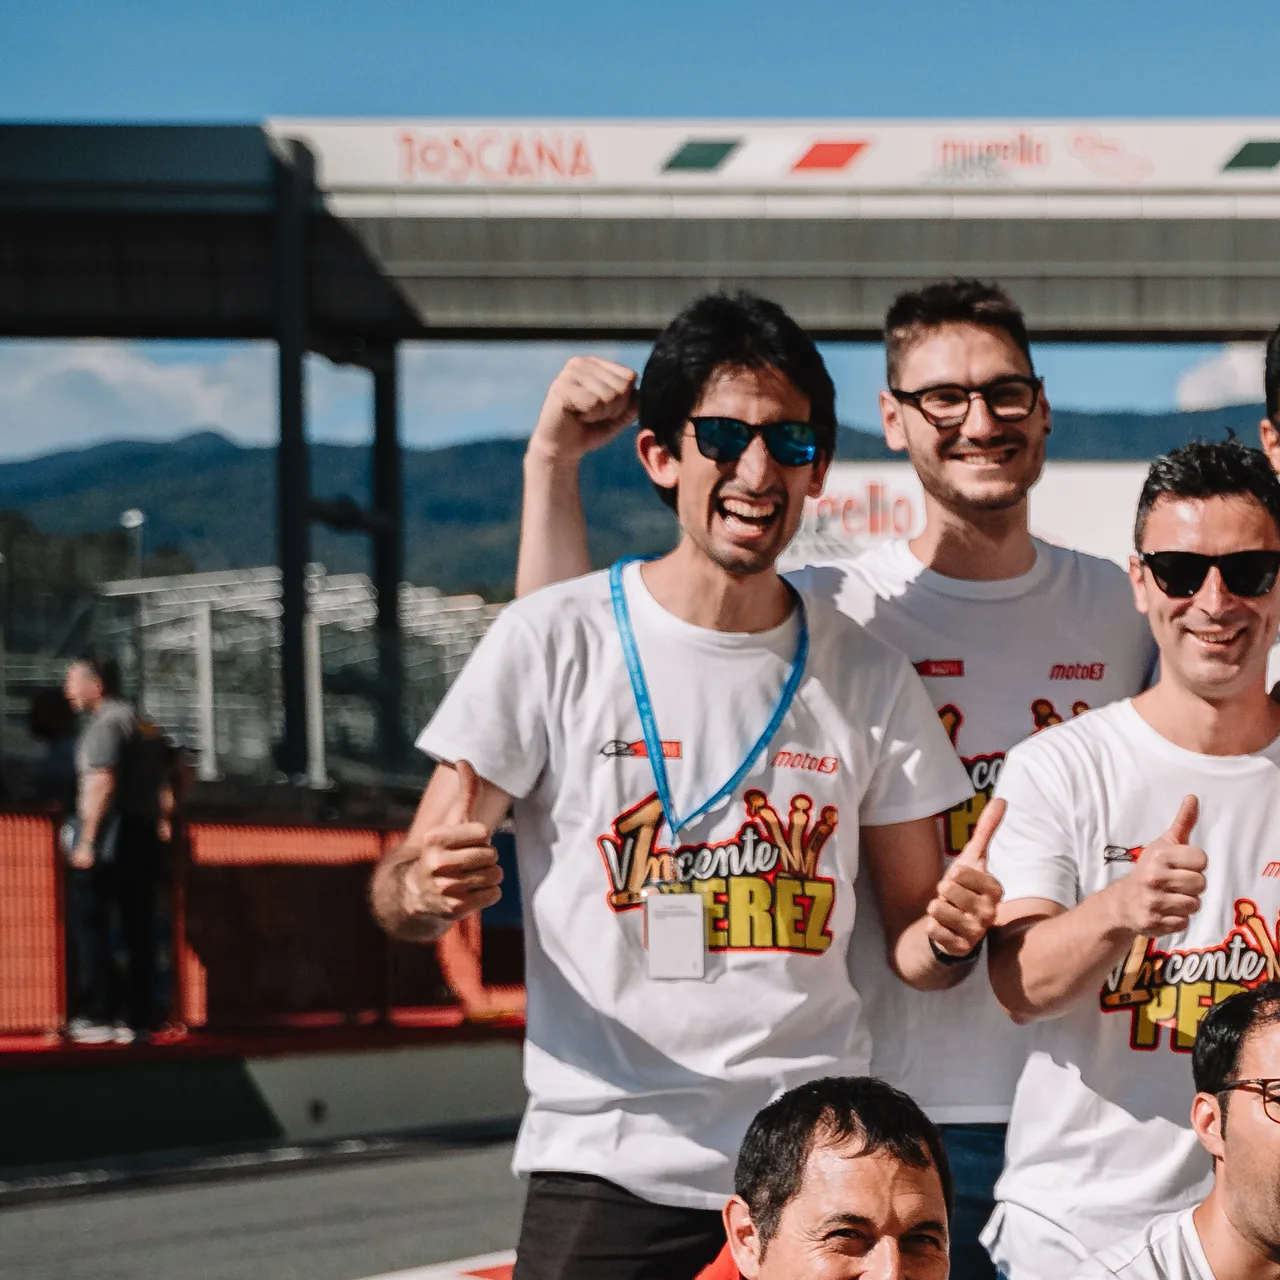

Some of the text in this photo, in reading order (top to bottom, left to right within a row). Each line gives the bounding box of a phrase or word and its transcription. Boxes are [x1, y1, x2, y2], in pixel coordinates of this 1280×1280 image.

[1049, 662, 1105, 681] moto3
[770, 750, 839, 775] moto3
[664, 875, 836, 951] EREZ
